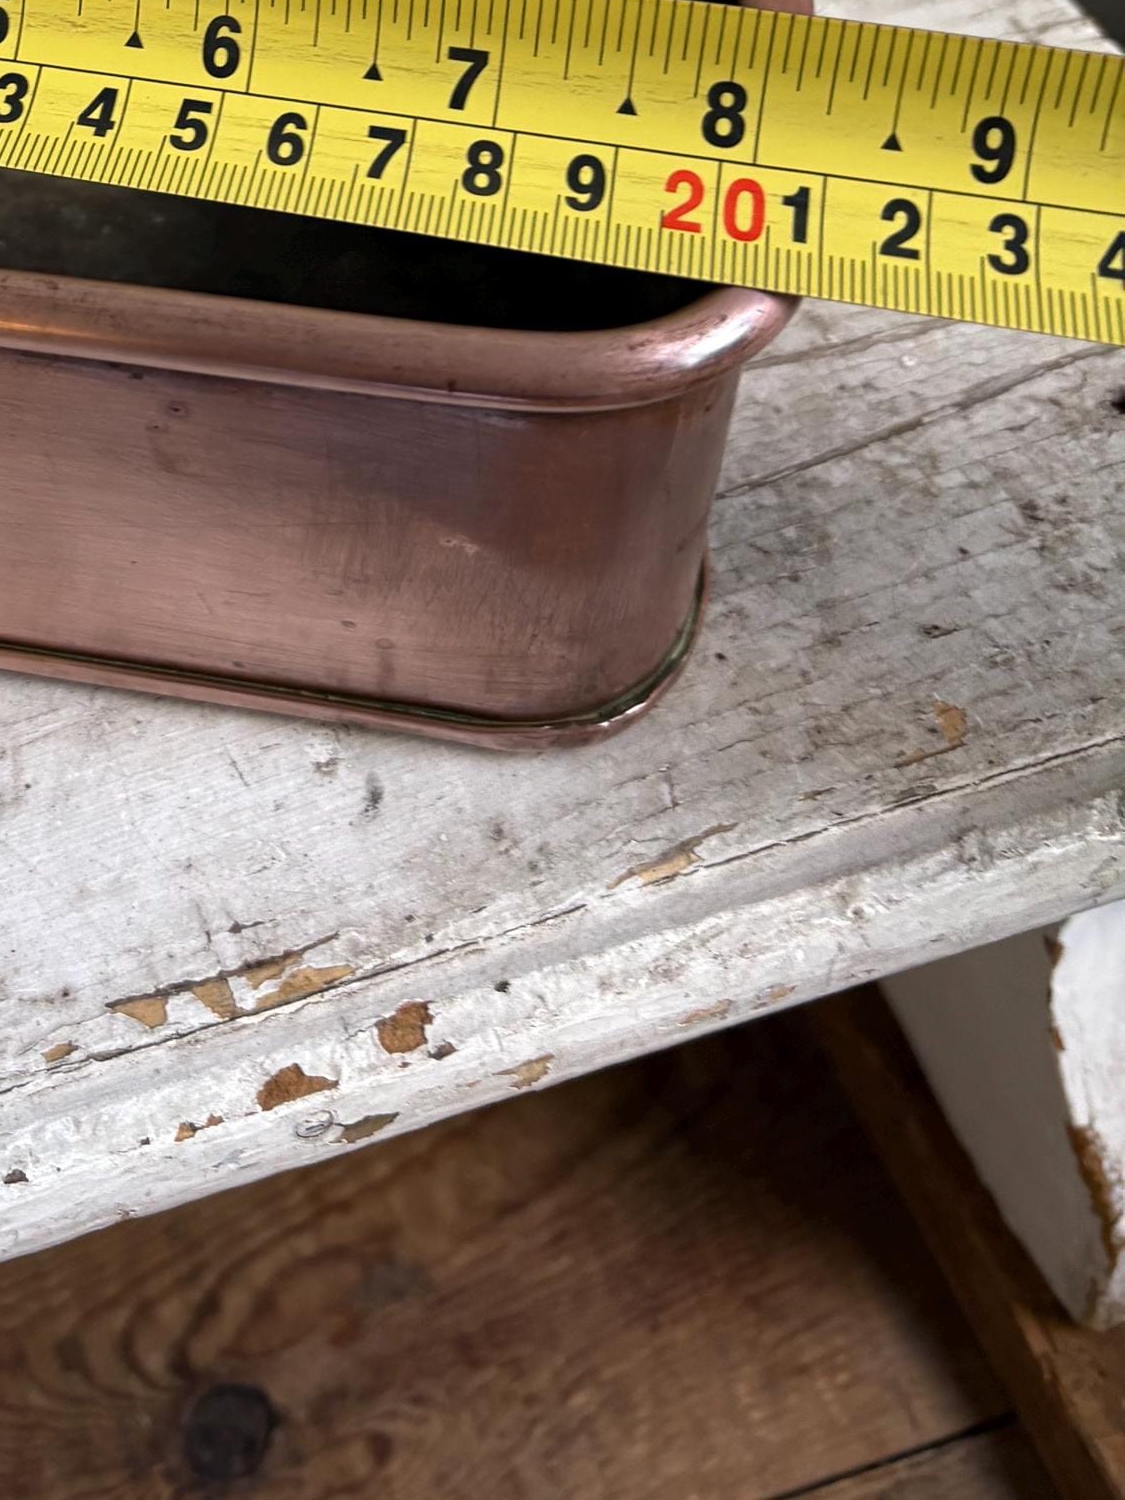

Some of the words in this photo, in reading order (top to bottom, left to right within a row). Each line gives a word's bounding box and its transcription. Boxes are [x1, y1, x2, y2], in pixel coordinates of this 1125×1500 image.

[77, 87, 118, 137] 4
[169, 98, 213, 151] 5
[266, 112, 307, 166] 6
[366, 125, 407, 179] 7
[462, 140, 504, 196] 8
[565, 154, 606, 211] 9
[661, 169, 766, 242] 20
[782, 186, 812, 244] 1
[879, 198, 922, 260] 2
[987, 213, 1030, 276] 3
[202, 15, 242, 78] 6
[447, 46, 490, 110] 7
[701, 81, 747, 148] 8
[969, 116, 1015, 185] 9
